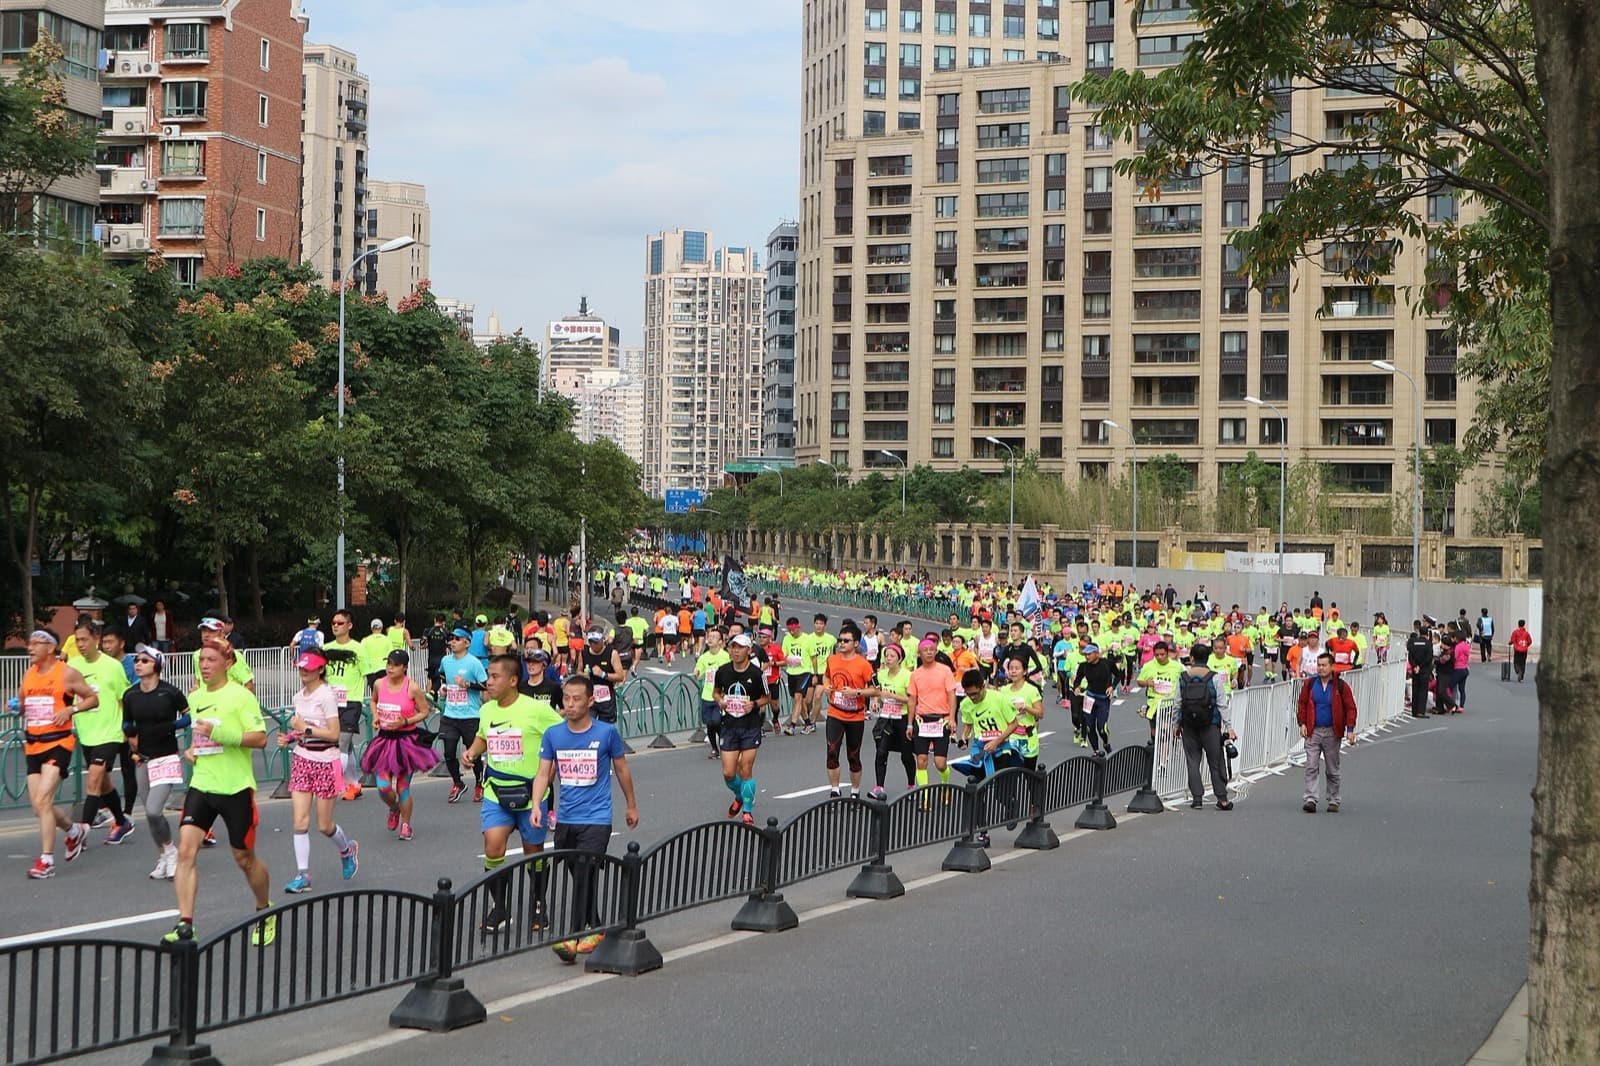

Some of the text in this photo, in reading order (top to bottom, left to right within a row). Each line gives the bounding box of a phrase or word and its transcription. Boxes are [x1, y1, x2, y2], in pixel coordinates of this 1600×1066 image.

[978, 717, 999, 731] SH
[488, 739, 520, 750] C15931
[561, 763, 595, 774] C14693
